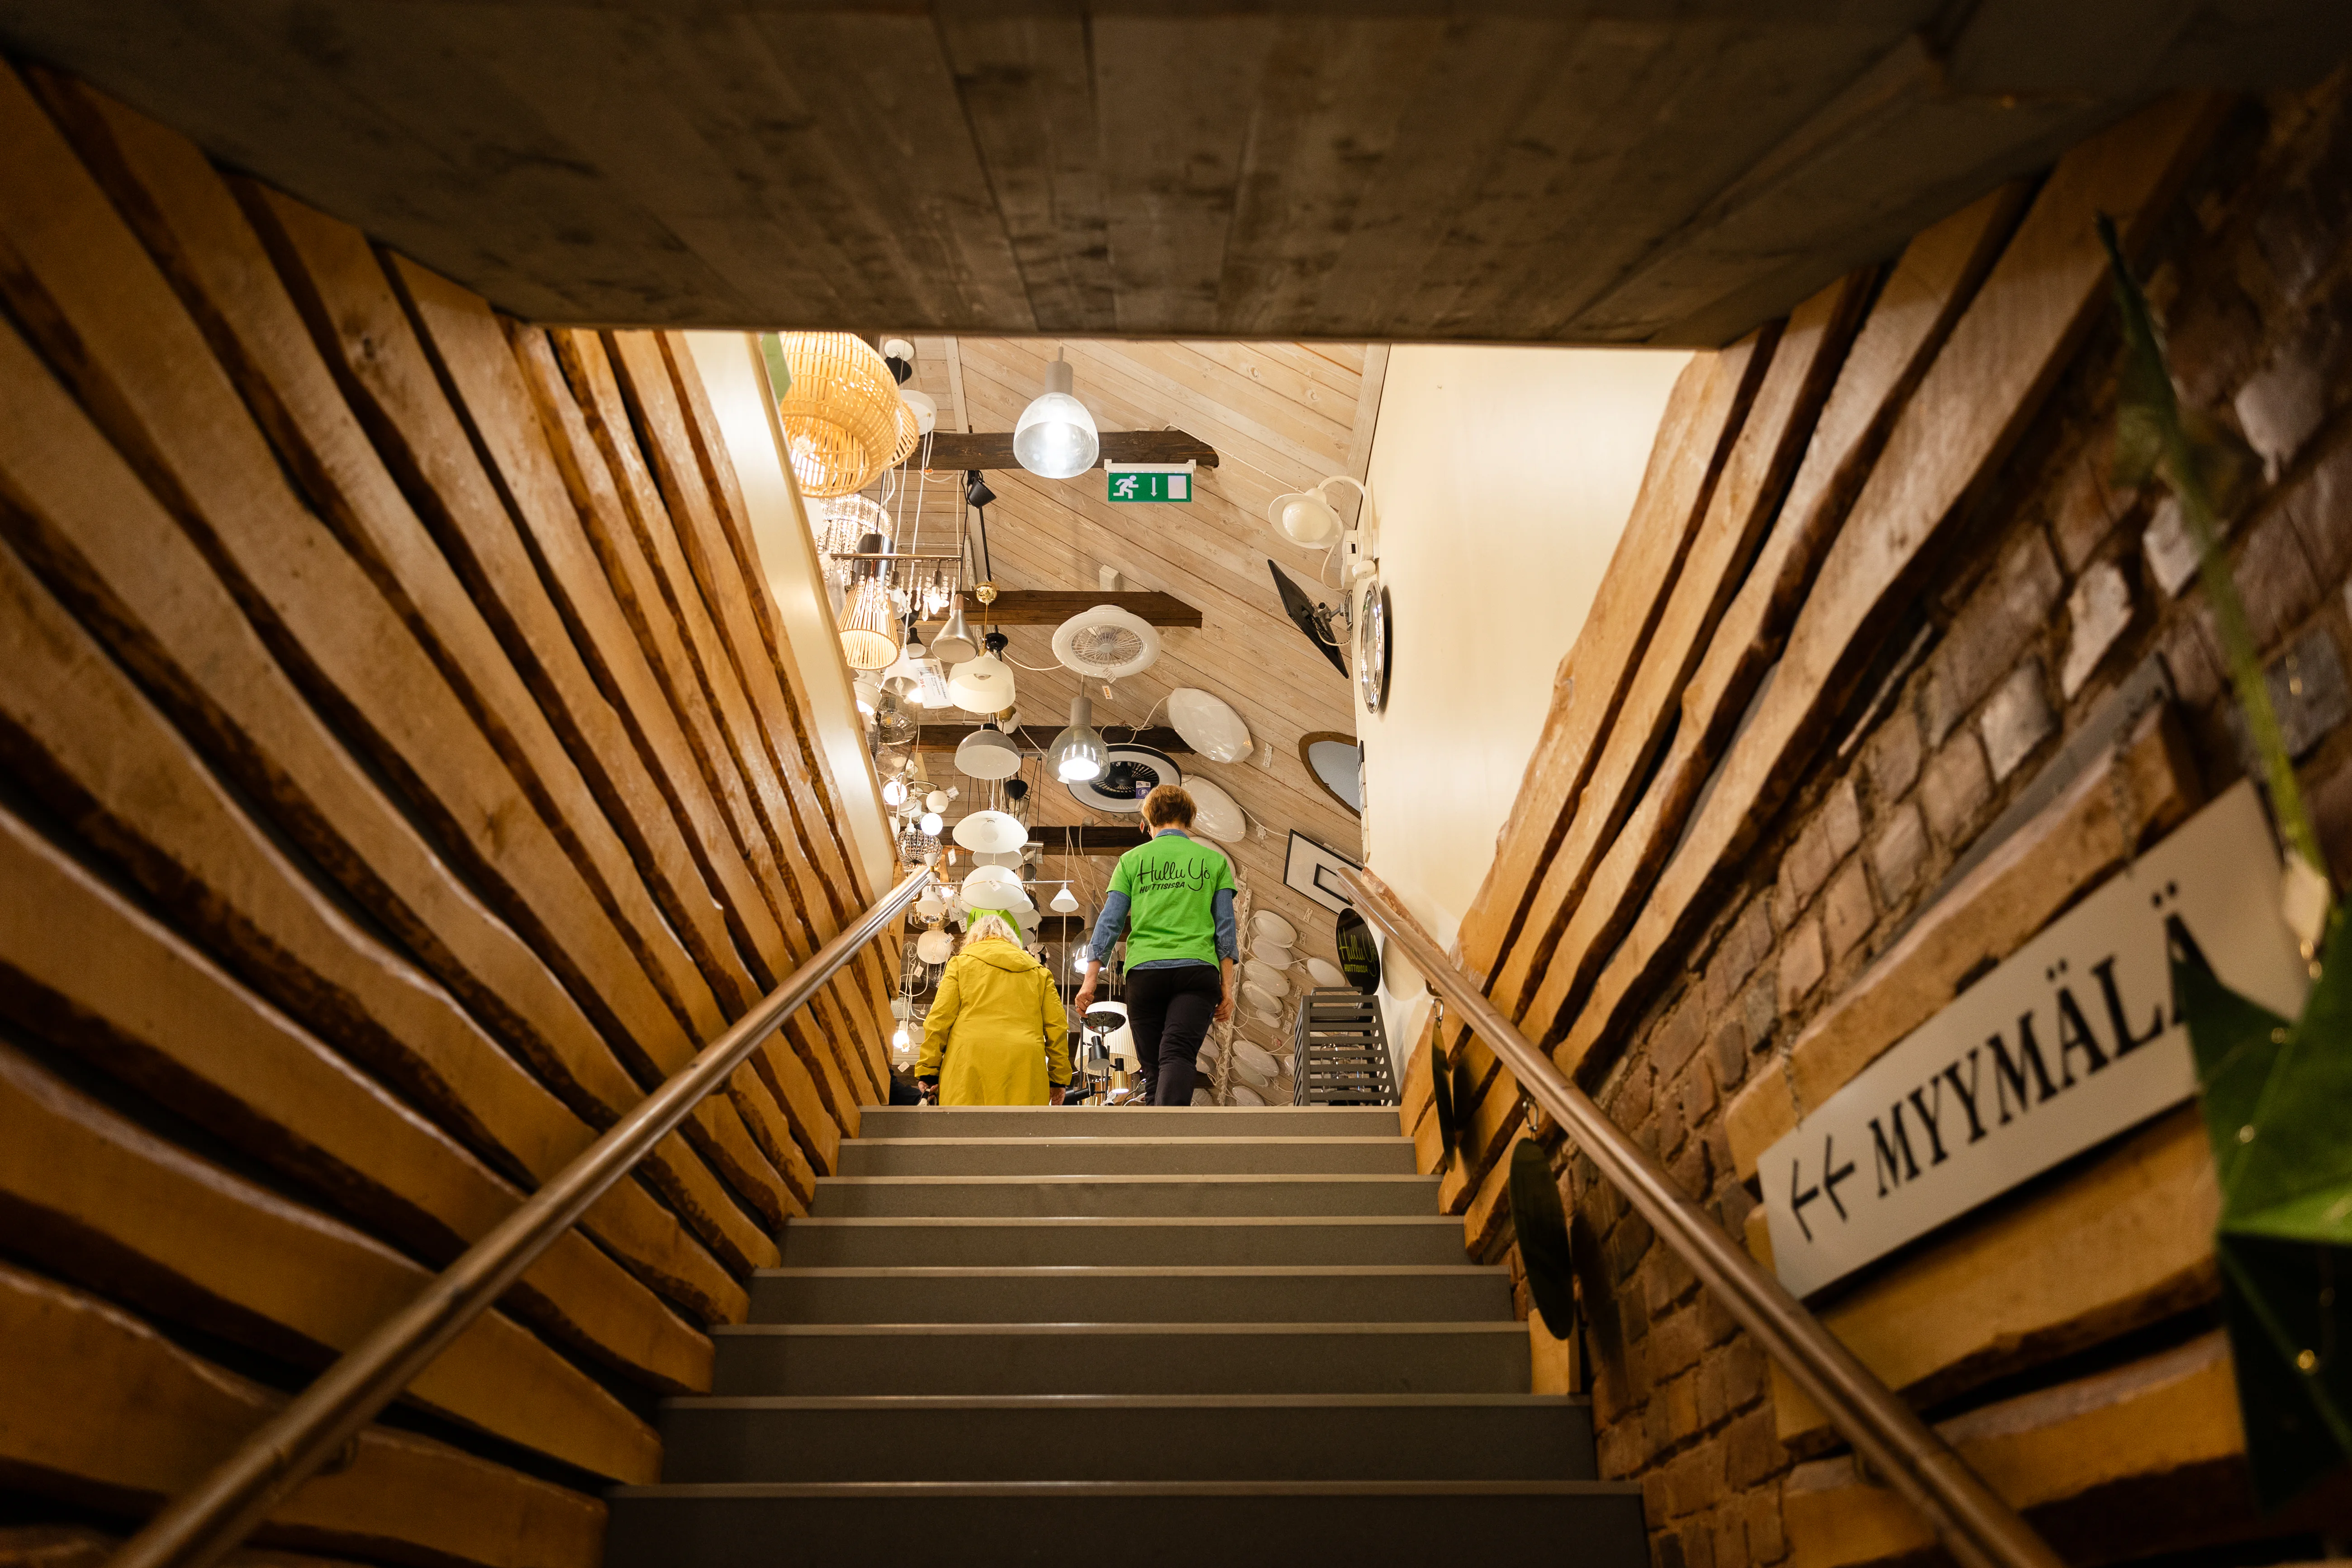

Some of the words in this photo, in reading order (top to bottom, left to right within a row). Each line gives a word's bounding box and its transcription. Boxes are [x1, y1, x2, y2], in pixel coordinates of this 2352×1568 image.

[1137, 856, 1185, 884] Hullu
[1139, 881, 1185, 894] HUITTISISSA
[1337, 927, 1365, 962] Hullu
[1362, 933, 1377, 977] Yö
[1344, 964, 1368, 973] HUITTISISSA
